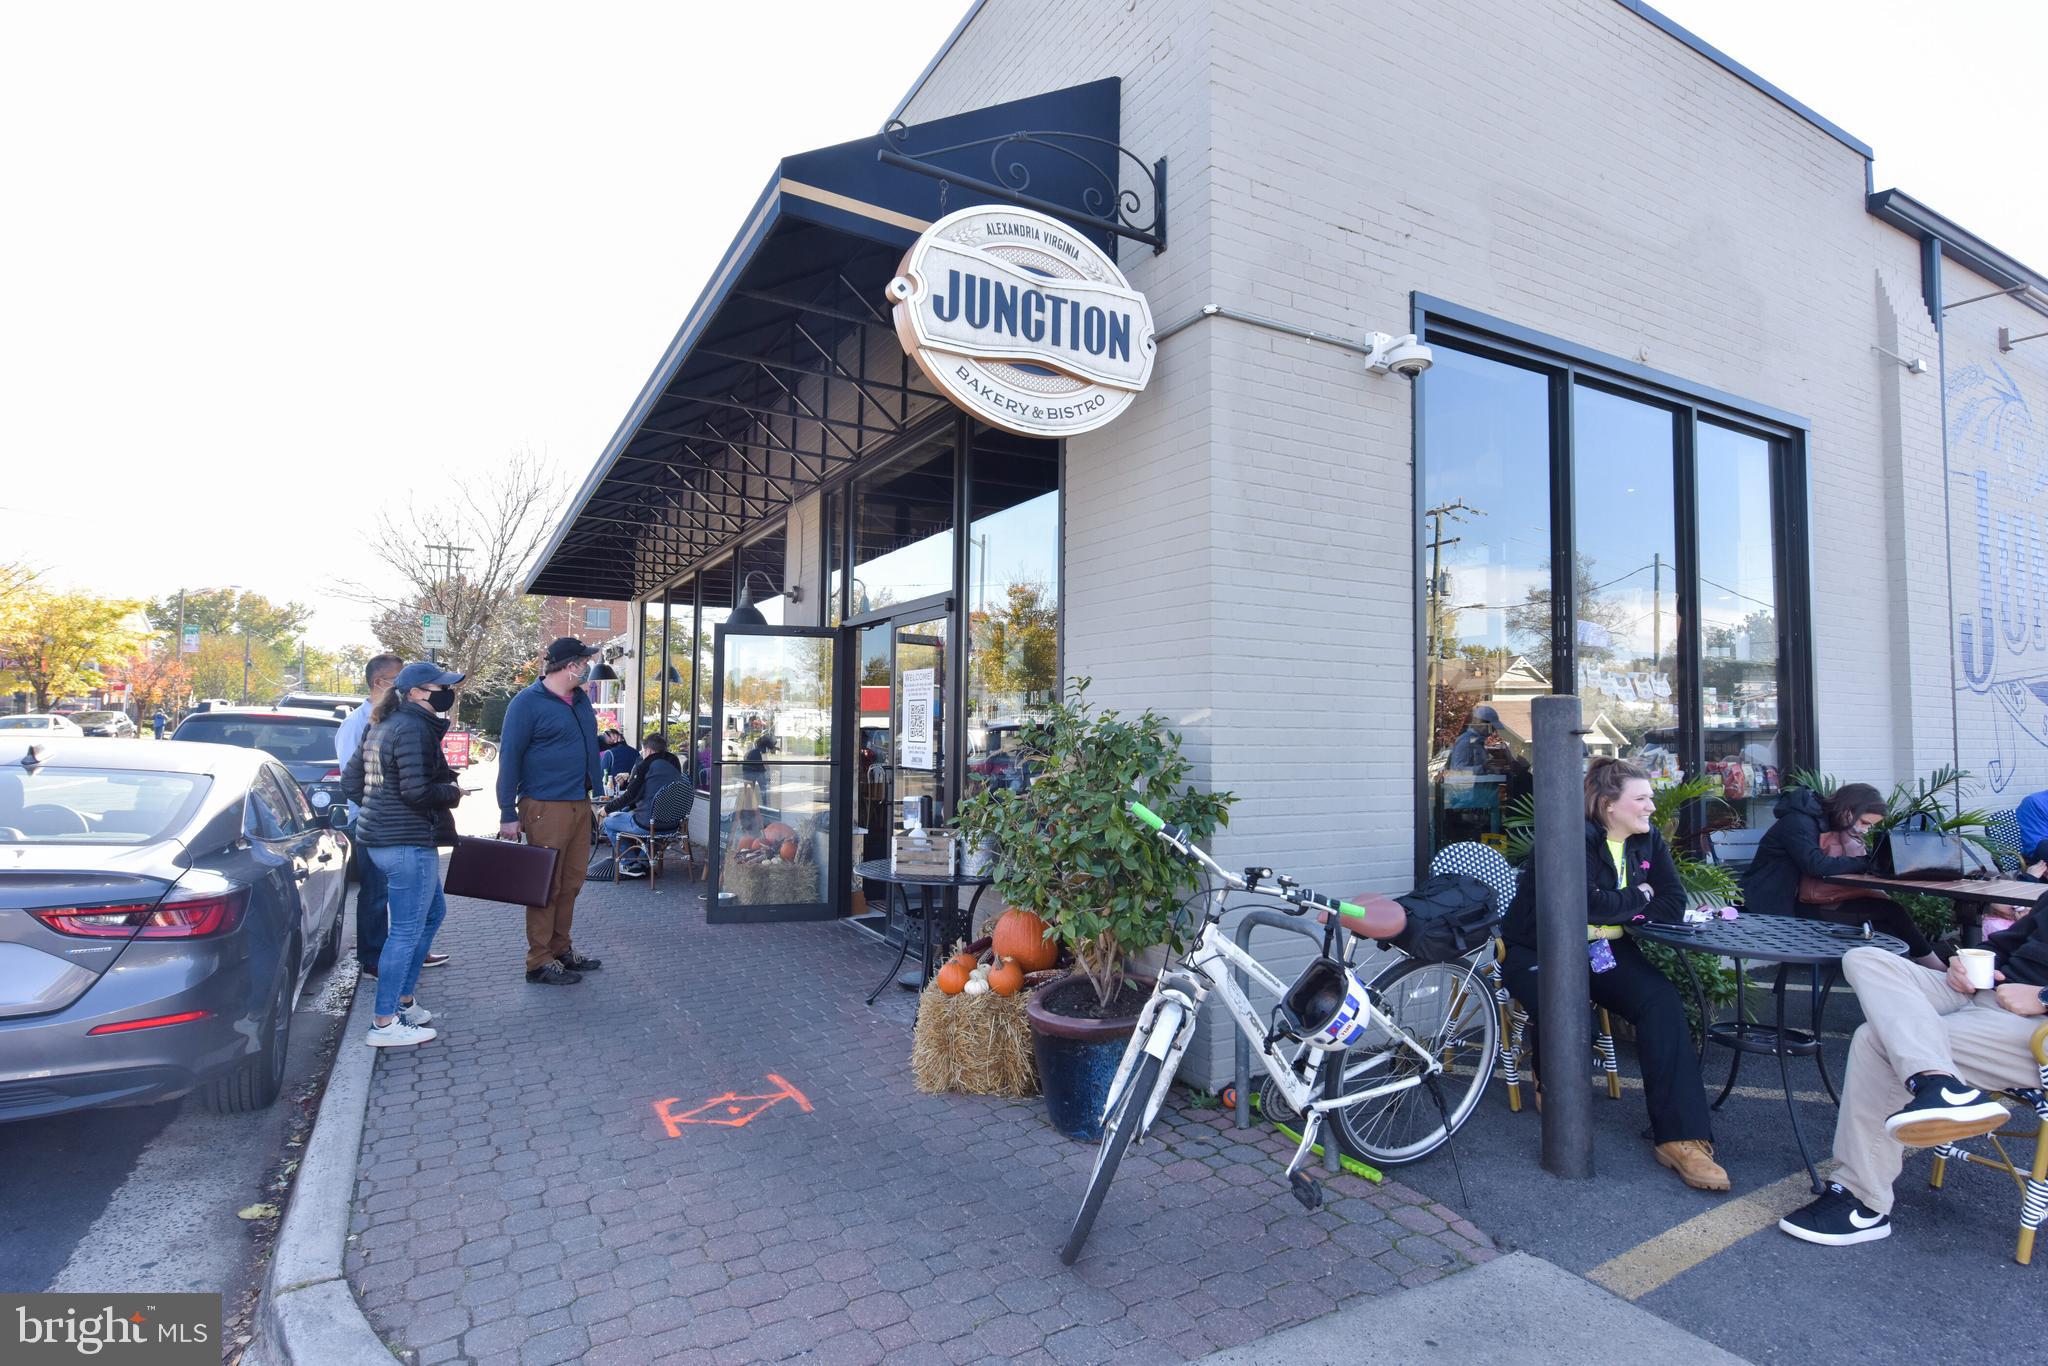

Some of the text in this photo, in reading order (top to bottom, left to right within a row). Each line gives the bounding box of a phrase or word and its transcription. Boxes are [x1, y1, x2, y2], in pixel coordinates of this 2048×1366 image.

[986, 222, 1080, 261] ALEXANDRIA VIRGINIA
[932, 269, 1131, 363] JUNCTION
[955, 365, 1106, 420] BAKERY & BISTRO
